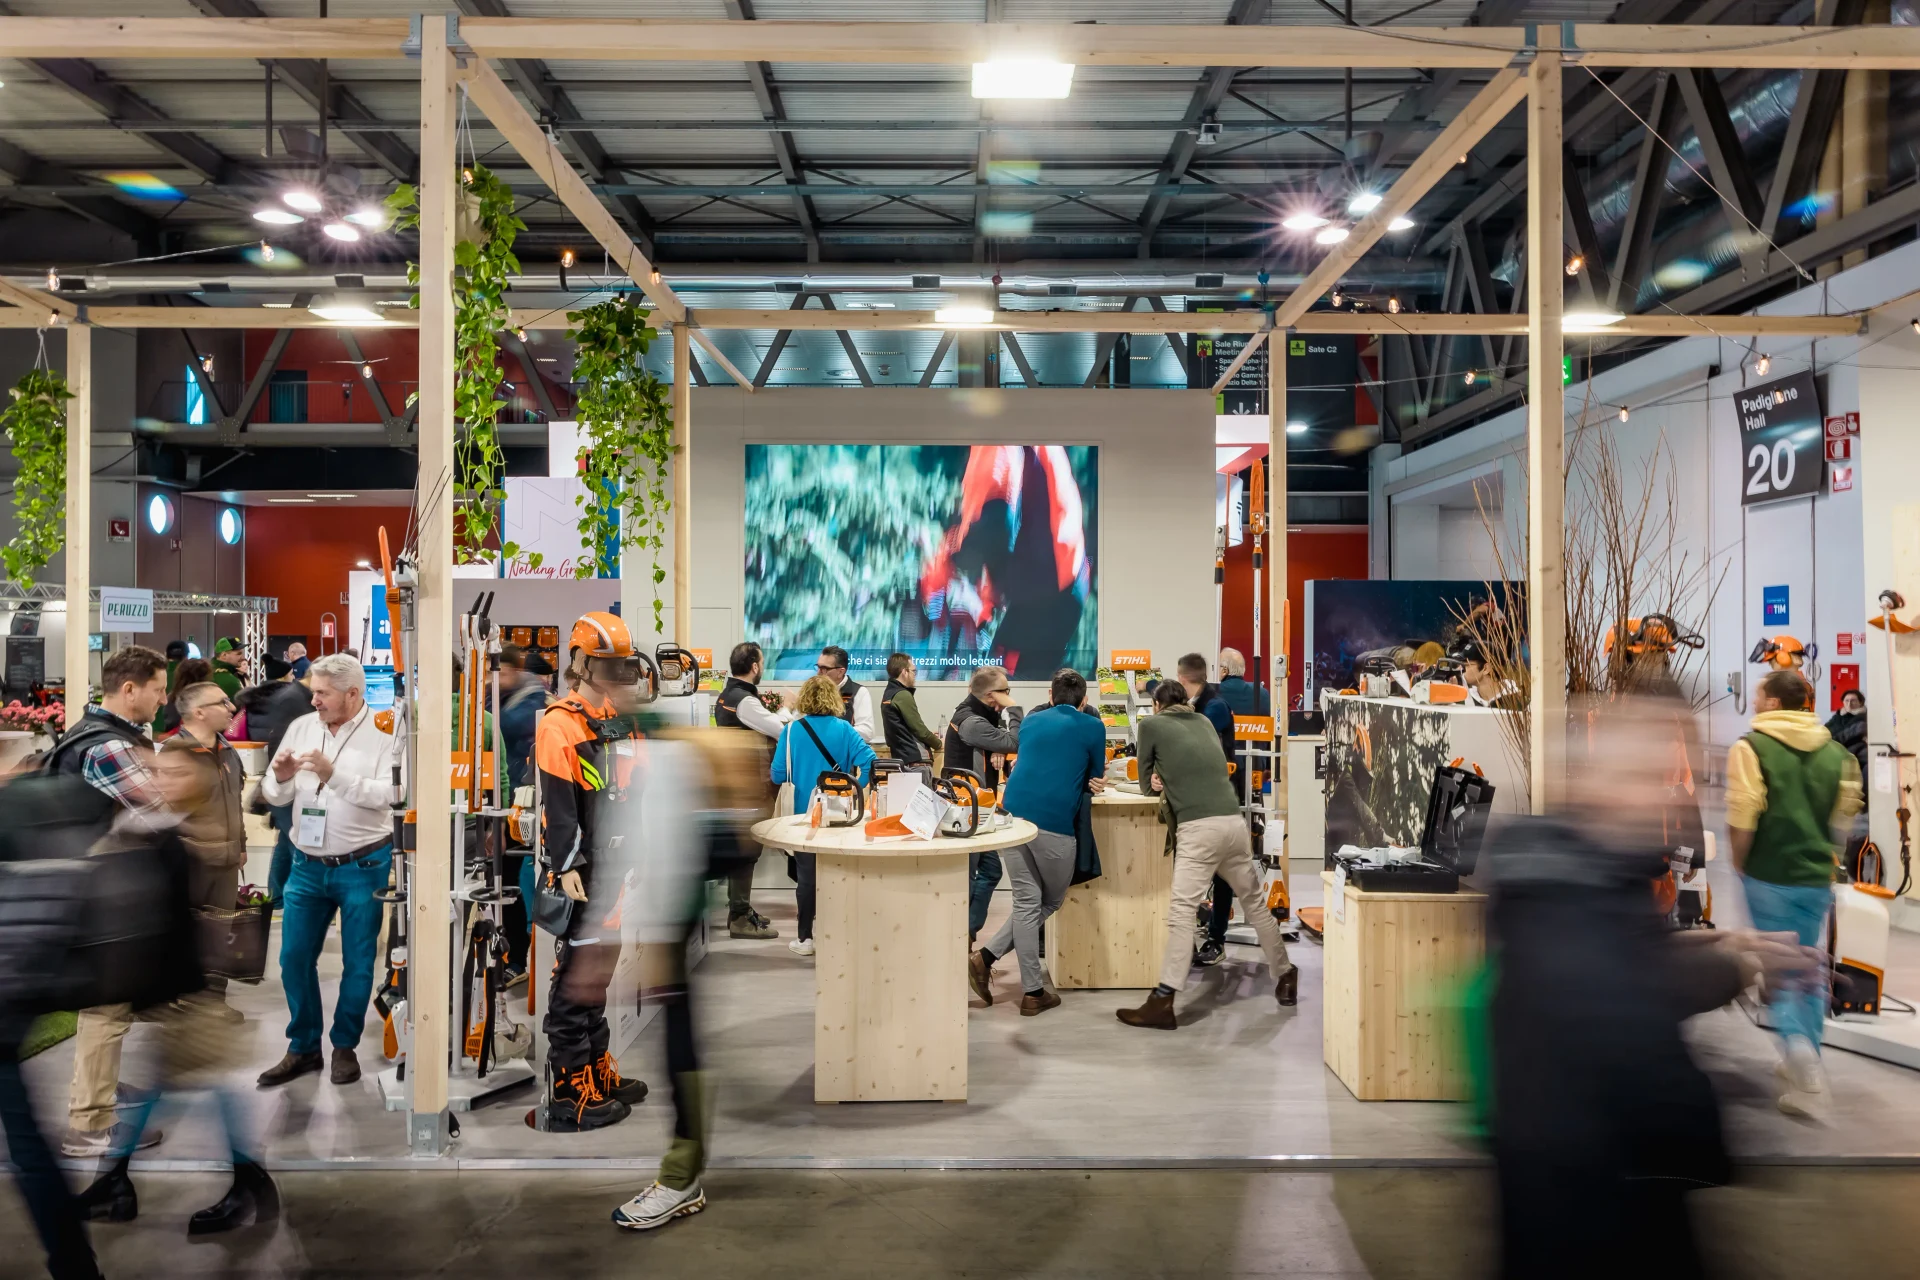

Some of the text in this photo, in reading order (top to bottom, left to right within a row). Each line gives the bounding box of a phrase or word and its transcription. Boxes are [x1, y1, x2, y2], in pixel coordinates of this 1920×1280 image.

[1215, 340, 1232, 348] Sale
[1326, 345, 1338, 353] C2
[1215, 349, 1243, 357] Meetin
[1745, 412, 1766, 431] Hall
[1746, 438, 1796, 496] 20
[107, 602, 149, 617] PERUZZO
[1773, 603, 1786, 615] TIM
[864, 655, 873, 666] ci
[939, 653, 967, 666] molto
[968, 653, 1003, 669] leggeri
[1114, 656, 1147, 665] STIHL
[1234, 723, 1269, 734] STIHL
